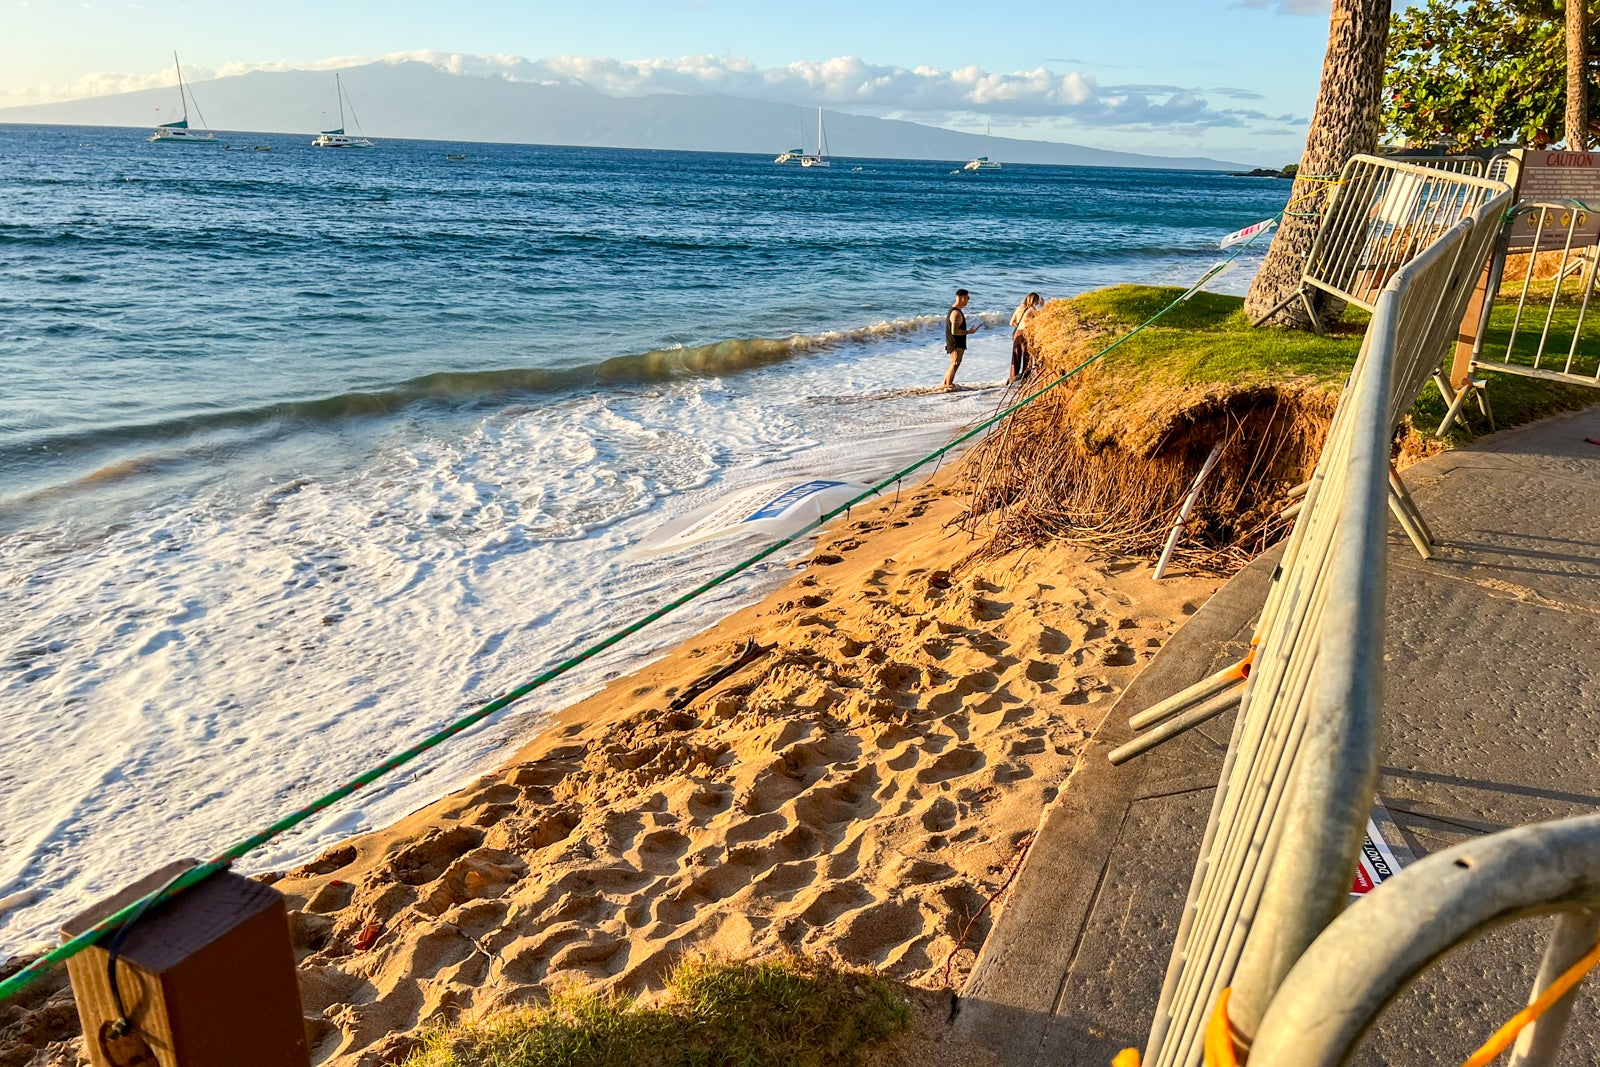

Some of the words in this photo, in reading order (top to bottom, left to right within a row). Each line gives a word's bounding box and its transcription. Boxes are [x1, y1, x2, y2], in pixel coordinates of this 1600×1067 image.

[1546, 152, 1594, 167] CAUTION
[1364, 845, 1382, 863] NOT
[1375, 862, 1391, 875] DO
